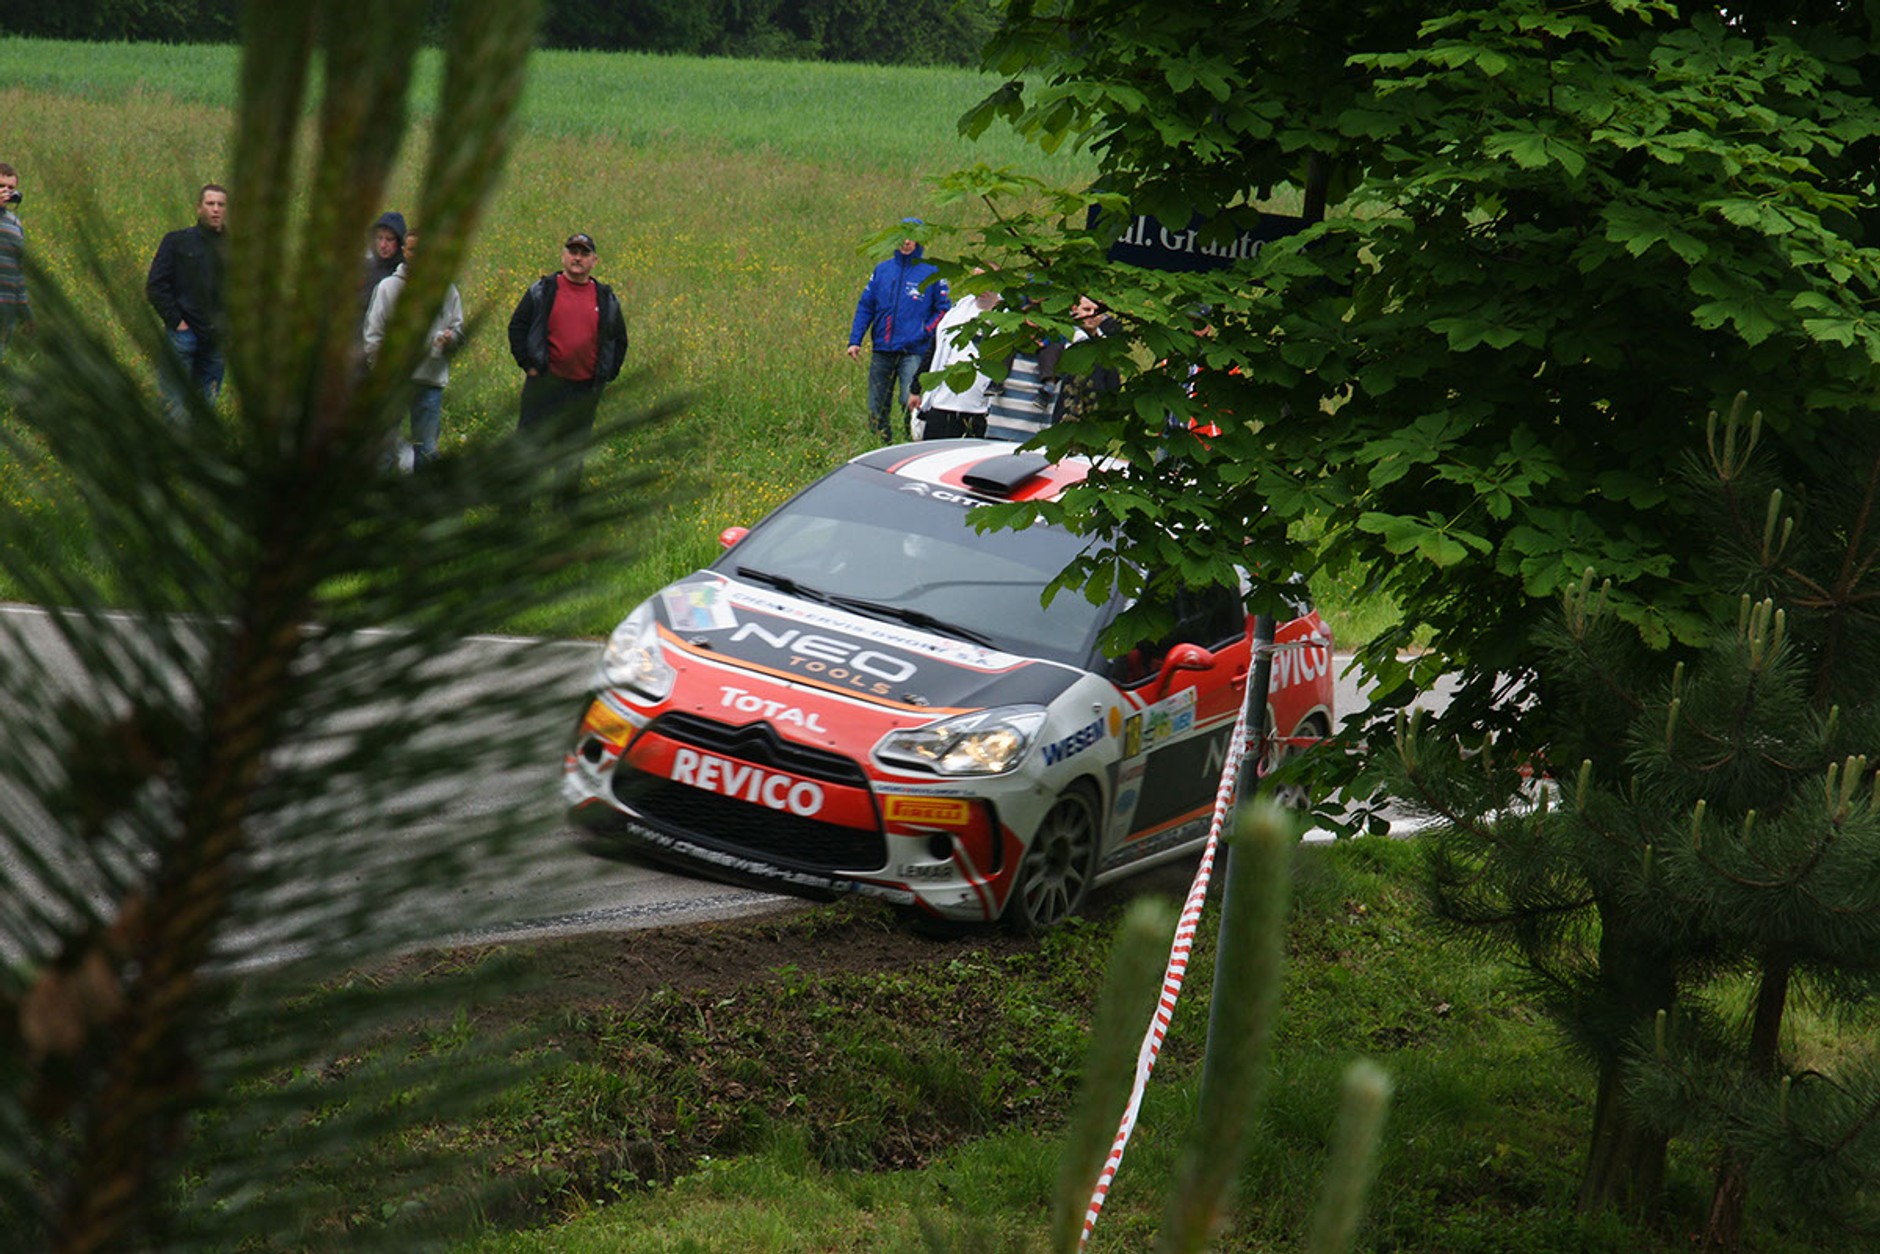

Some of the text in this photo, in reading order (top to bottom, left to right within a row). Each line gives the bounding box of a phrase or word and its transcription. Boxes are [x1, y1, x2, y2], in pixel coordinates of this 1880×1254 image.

[729, 622, 917, 683] NEO
[789, 655, 892, 695] TOOLS
[1269, 630, 1329, 694] EVICO
[719, 685, 827, 734] TOTAL
[1042, 717, 1106, 767] WESEM
[670, 748, 825, 817] REVICO
